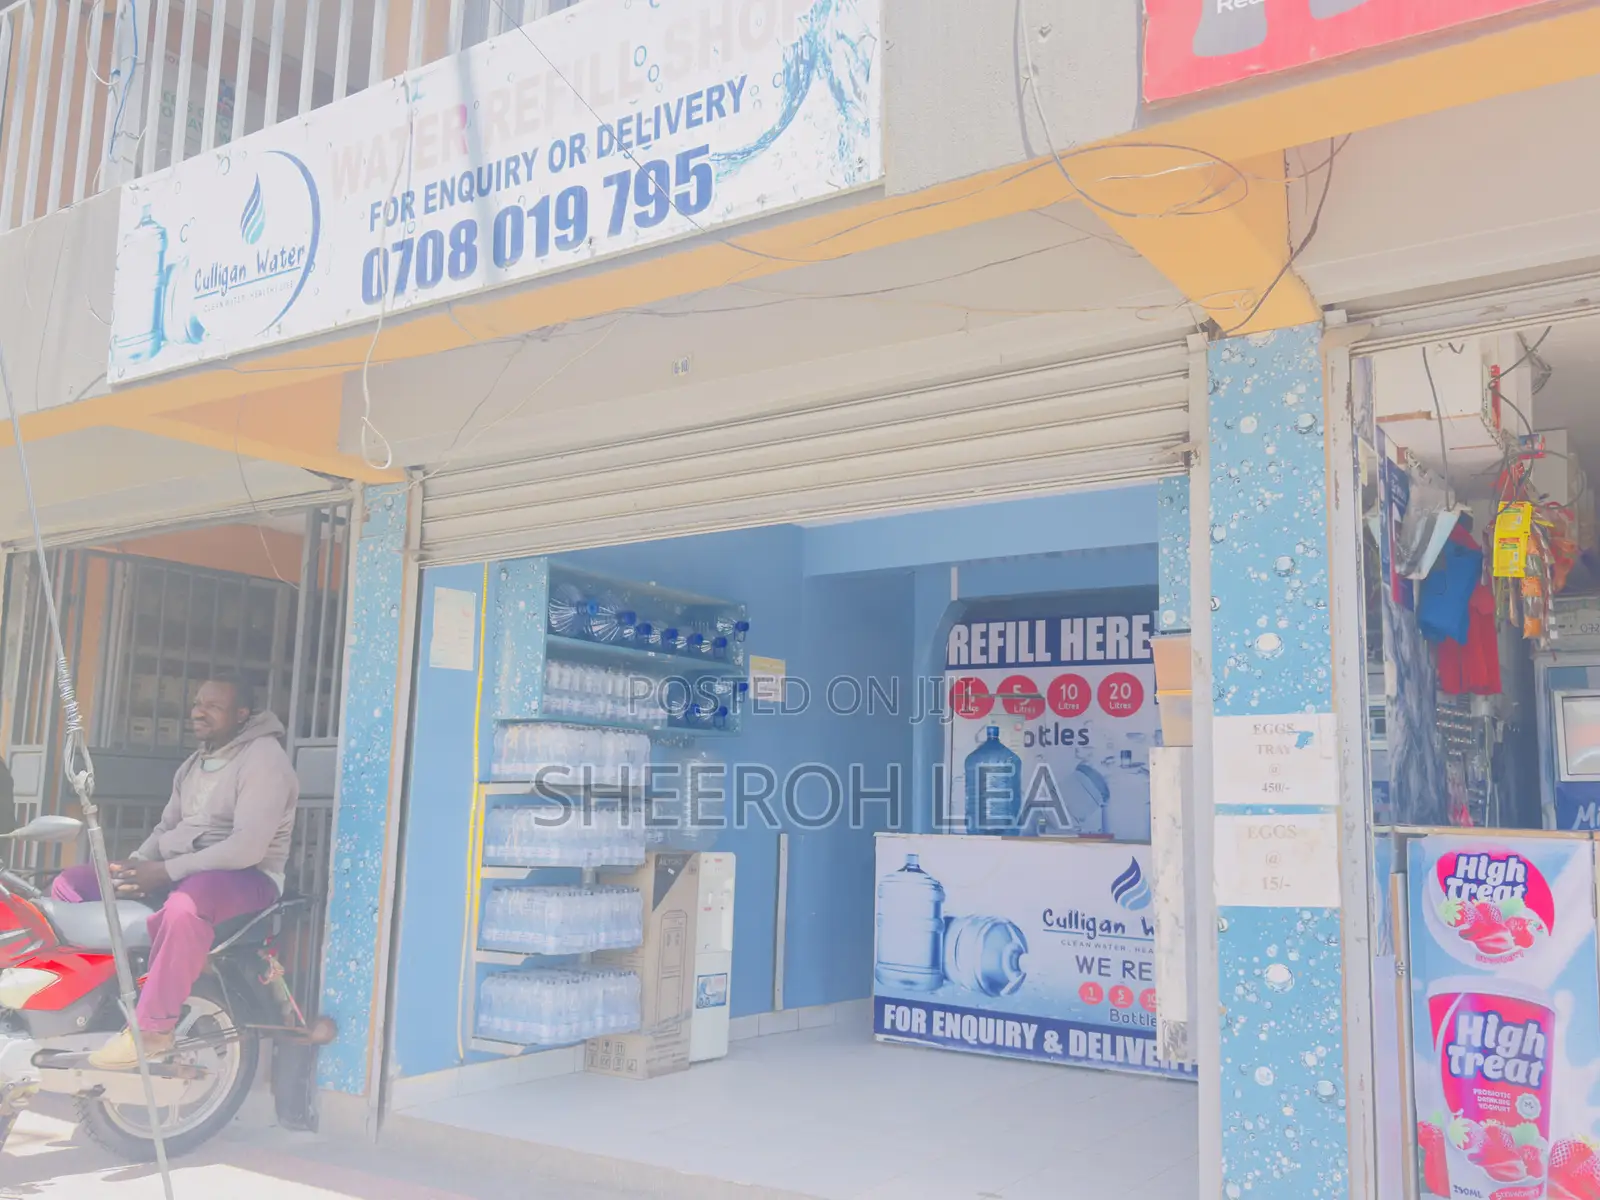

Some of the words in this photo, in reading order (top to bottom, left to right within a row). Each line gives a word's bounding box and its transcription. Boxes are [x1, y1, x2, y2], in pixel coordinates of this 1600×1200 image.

[329, 102, 469, 201] WATER
[482, 41, 649, 145] REFILL
[368, 187, 415, 233] FOR
[422, 148, 543, 216] ENQUIRY
[548, 133, 587, 175] OR
[595, 74, 749, 156] DELIVERY
[360, 219, 478, 307] 0708
[491, 184, 589, 269] 019
[603, 144, 714, 238] 795
[193, 262, 247, 298] Culligan
[256, 244, 306, 275] Water
[947, 619, 1052, 666] REFILL
[1060, 614, 1152, 662] HERE
[1060, 683, 1079, 702] 10
[1109, 682, 1132, 701] 20
[1057, 701, 1081, 711] Litres
[1109, 700, 1132, 711] Litres
[1252, 722, 1295, 736] EGGS
[1255, 744, 1291, 756] TRAY
[1269, 764, 1281, 776] @
[1261, 782, 1291, 794] 450/-
[1247, 824, 1297, 840] EGGS
[1264, 850, 1282, 867] @
[1454, 852, 1529, 888] High
[1261, 876, 1291, 891] 15/-
[1445, 877, 1529, 903] Treat
[1042, 907, 1126, 940] Culligan
[1060, 938, 1092, 949] CLEAN
[1075, 953, 1112, 978] WE
[882, 1003, 927, 1036] FOR
[931, 1010, 1038, 1052] ENQUIRY
[1042, 1029, 1064, 1055] &
[1456, 1010, 1547, 1063] High
[1446, 1044, 1545, 1088] Treat
